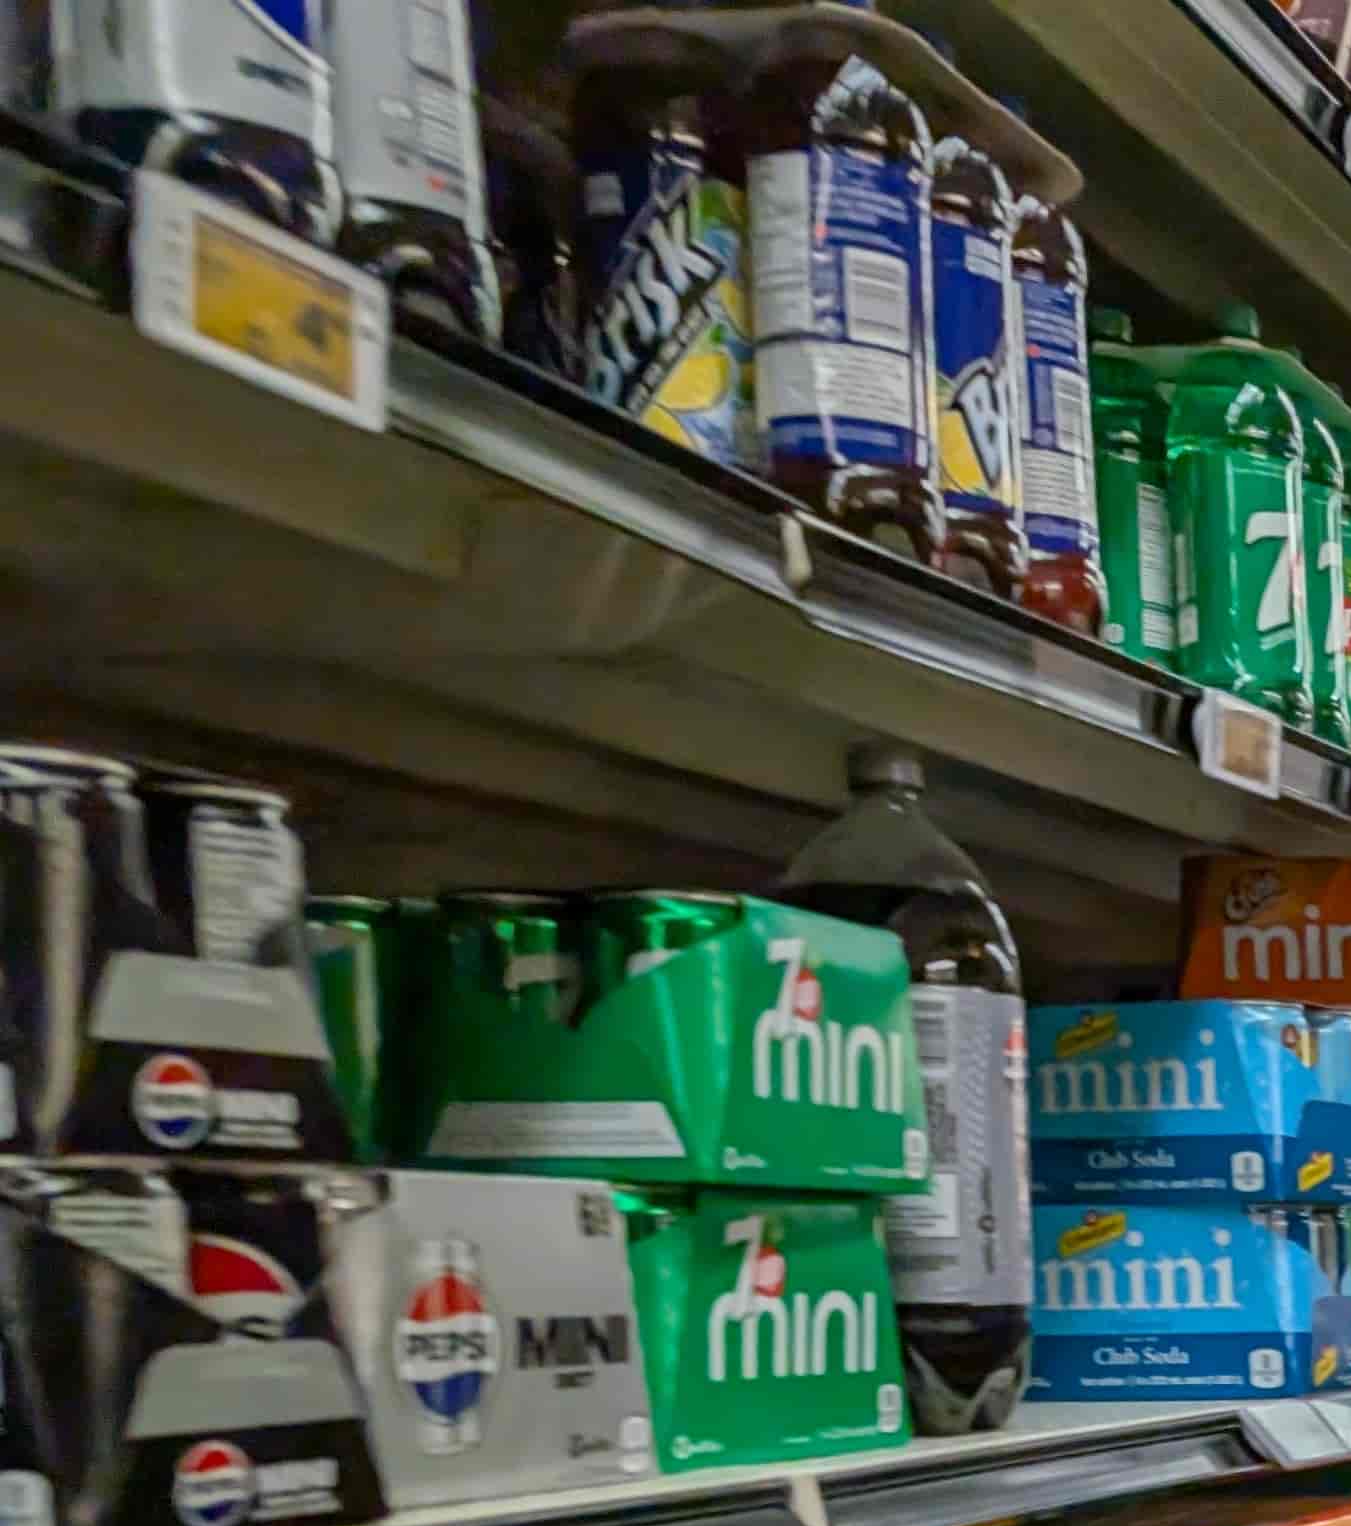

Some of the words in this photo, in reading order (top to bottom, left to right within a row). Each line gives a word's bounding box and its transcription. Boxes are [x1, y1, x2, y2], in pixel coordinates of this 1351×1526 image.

[752, 1009, 906, 1114] mini
[1038, 1029, 1224, 1114] mini
[1131, 1149, 1175, 1170] Soda
[1040, 1228, 1241, 1312] mini
[708, 1290, 877, 1382] mini
[1094, 1346, 1136, 1366] Club
[1140, 1345, 1190, 1366] Soda
